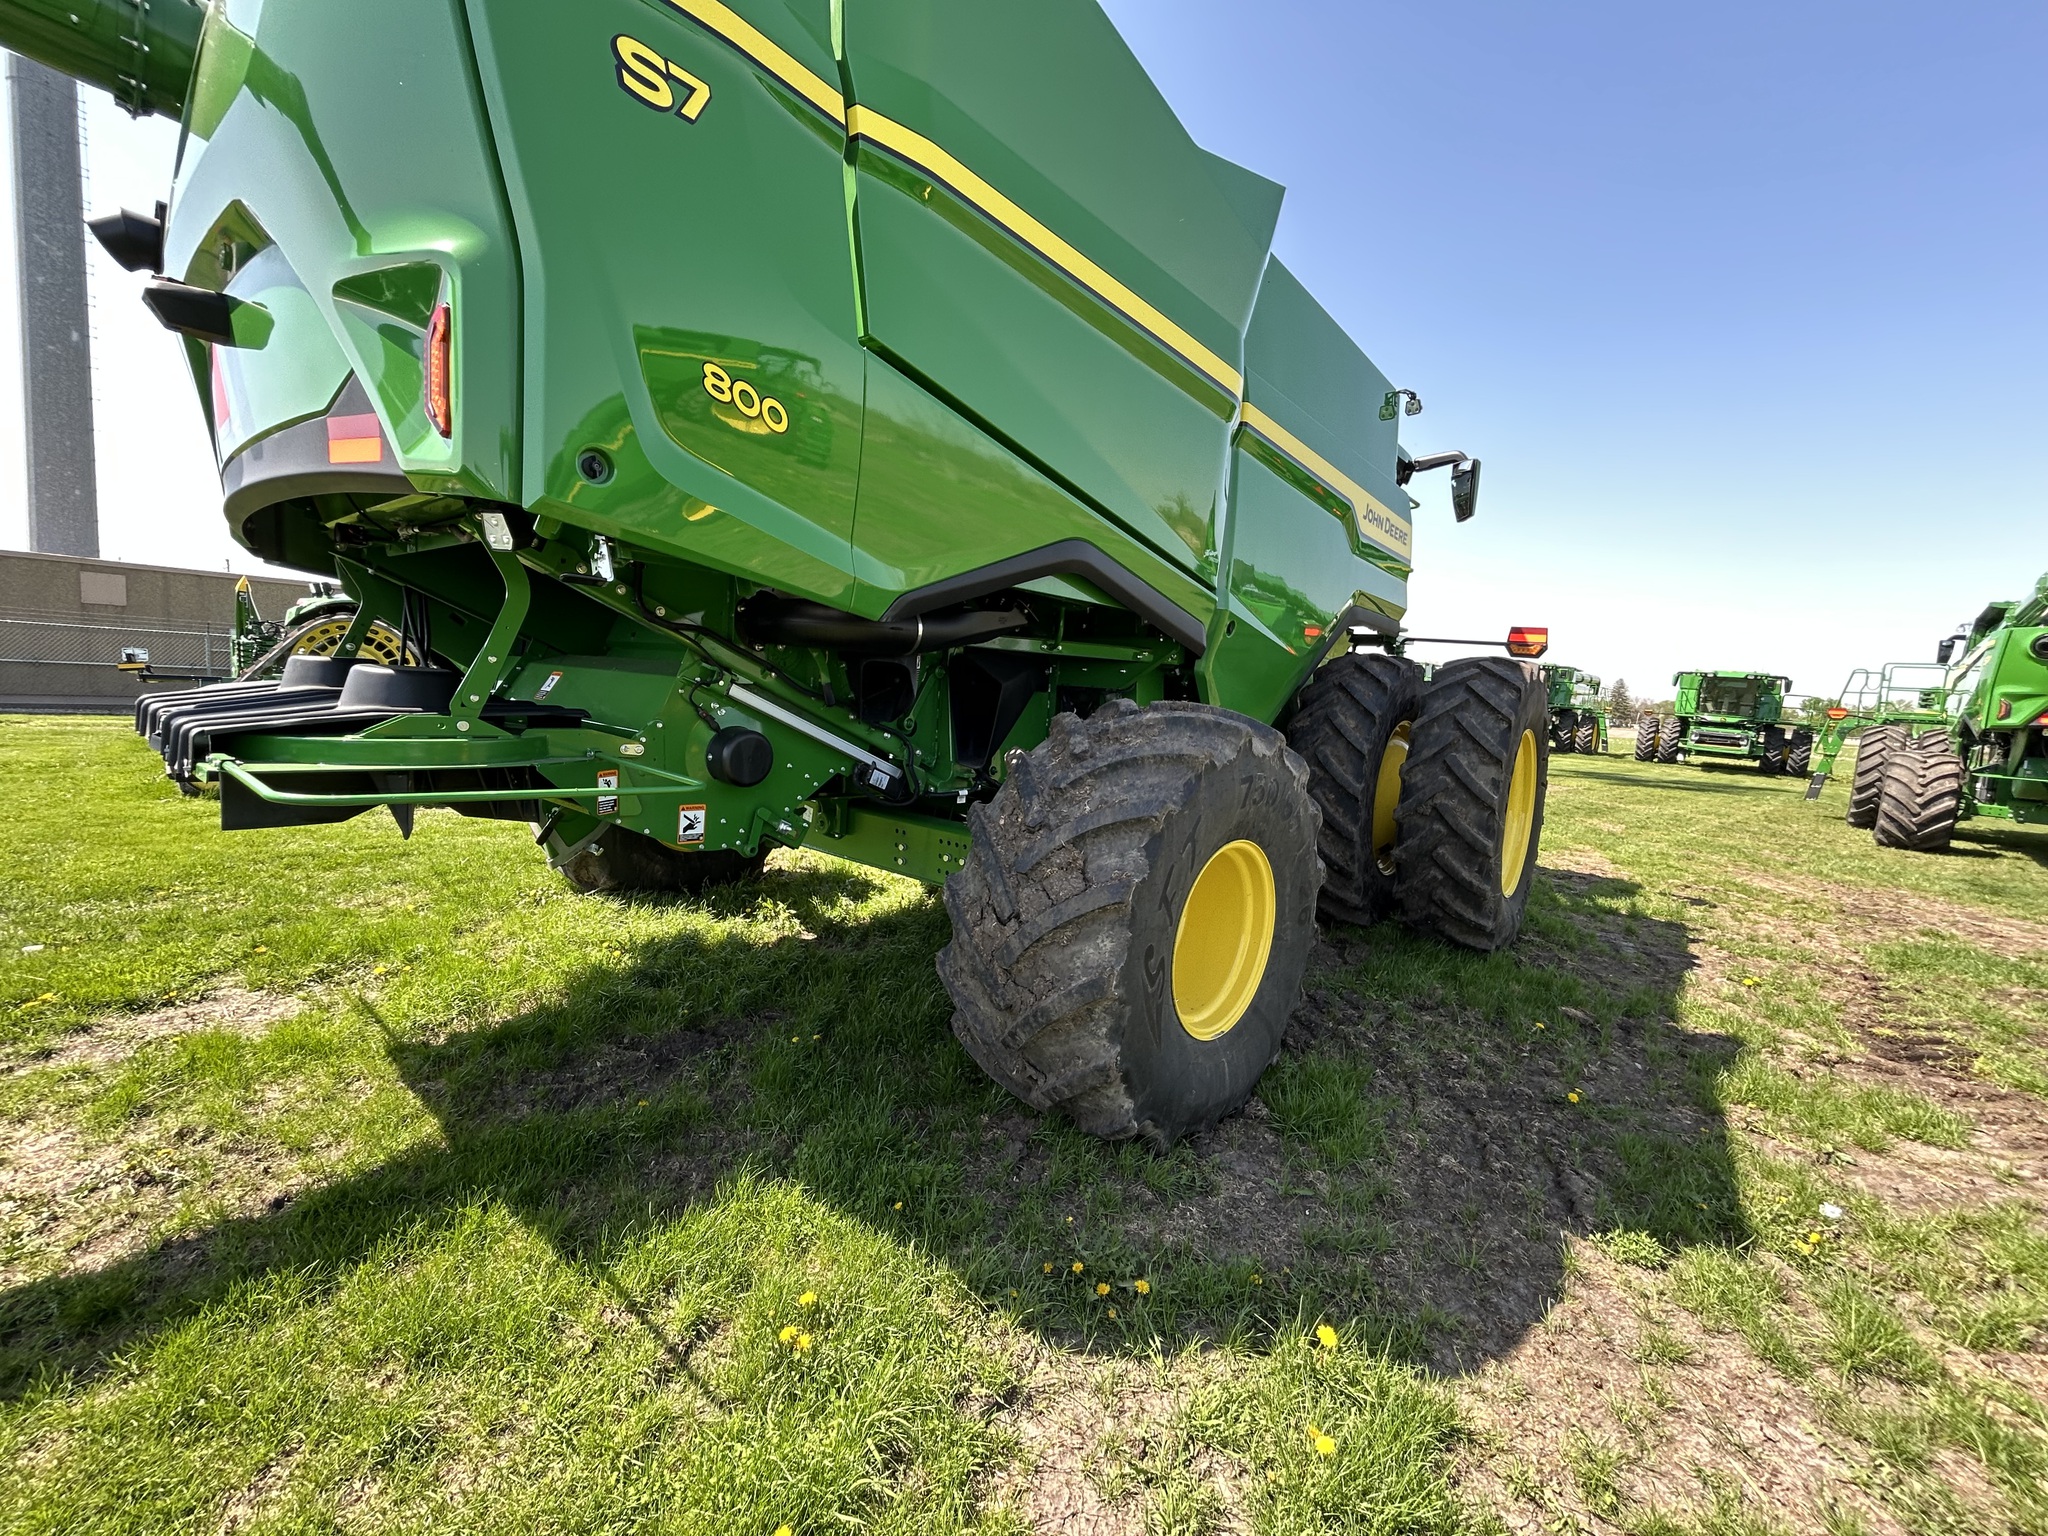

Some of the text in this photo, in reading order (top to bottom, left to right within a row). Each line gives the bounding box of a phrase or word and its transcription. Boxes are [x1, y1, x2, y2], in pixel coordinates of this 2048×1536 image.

[611, 33, 712, 125] S7
[702, 362, 789, 434] 800
[1362, 503, 1408, 546] JOHN DEERE
